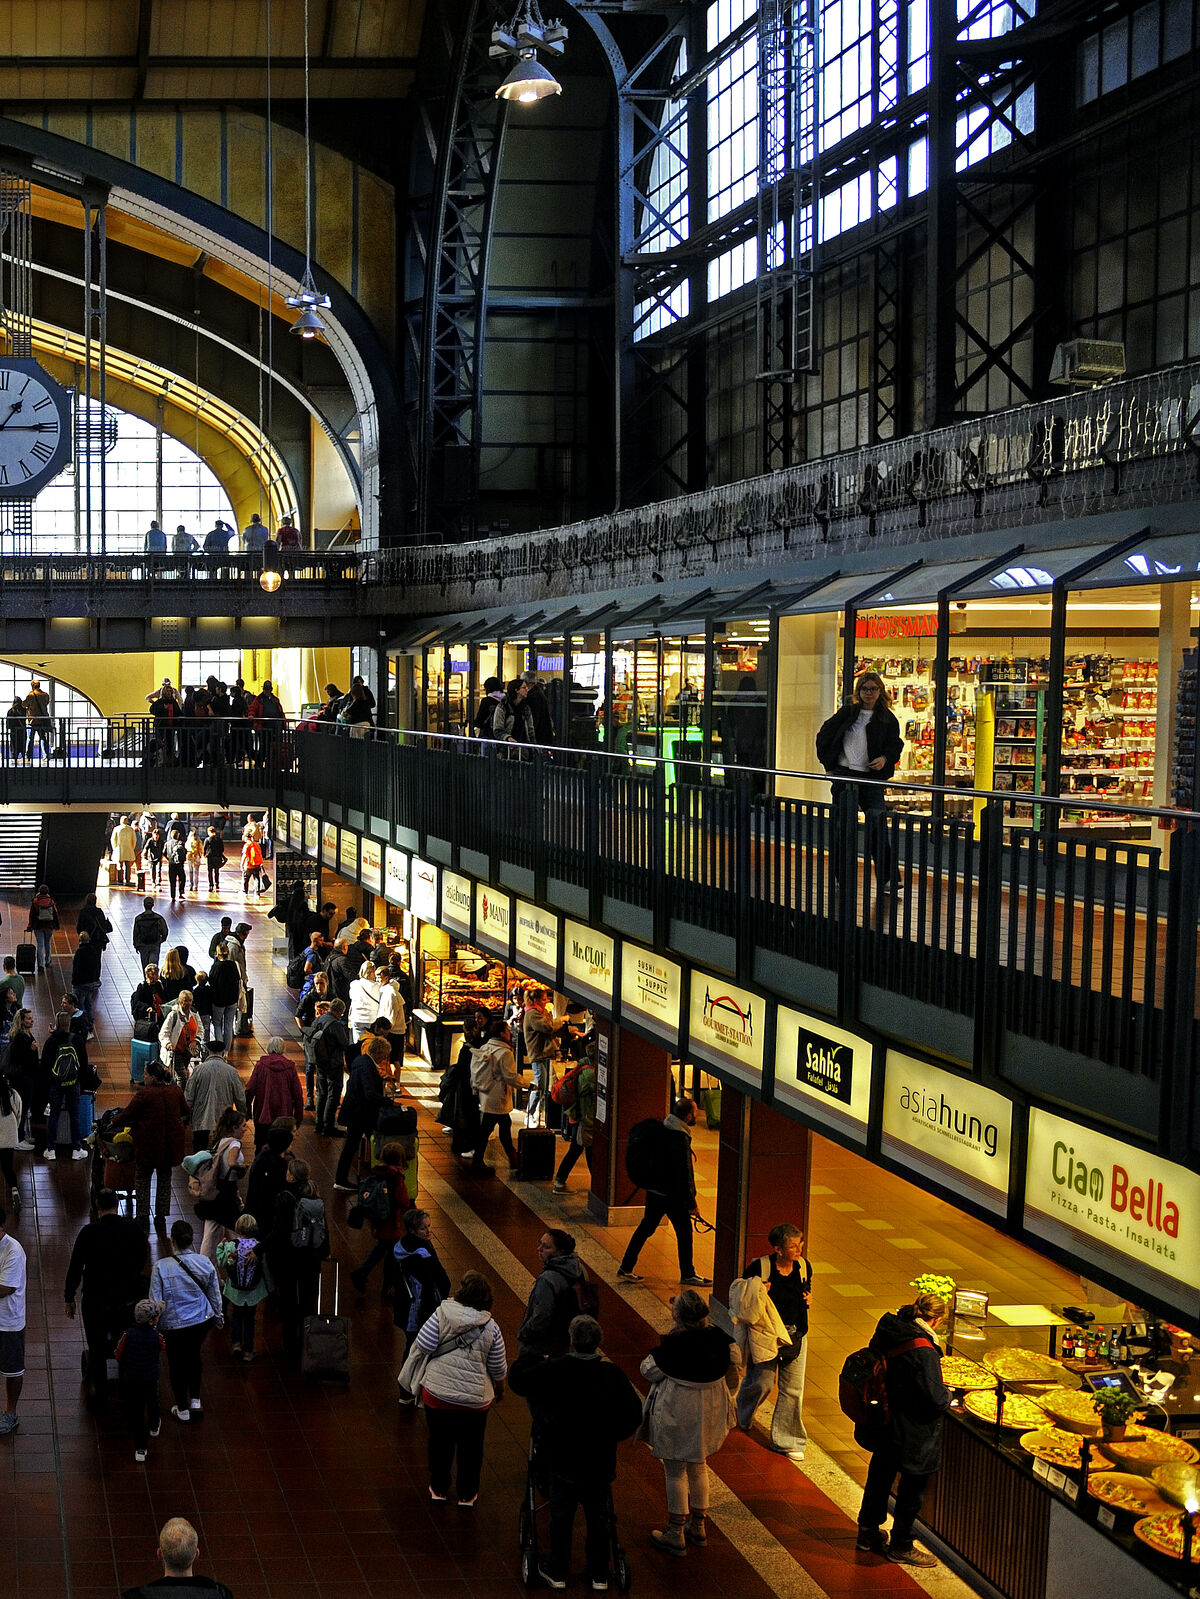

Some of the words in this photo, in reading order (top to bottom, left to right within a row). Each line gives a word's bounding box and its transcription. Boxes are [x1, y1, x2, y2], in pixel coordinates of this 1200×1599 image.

[20, 378, 31, 396] I
[32, 397, 52, 412] II
[19, 460, 33, 479] V
[868, 614, 940, 639] ROSSMAN
[638, 960, 655, 973] SUSHI
[645, 979, 667, 994] SUPPLY
[806, 1042, 842, 1082] Sahha
[900, 1086, 998, 1157] asiahung
[1052, 1141, 1104, 1202] Ciao
[1111, 1164, 1179, 1238] Bella
[1051, 1191, 1078, 1213] Pizza
[1088, 1208, 1116, 1232] Pasta
[1126, 1226, 1176, 1260] Insalata
